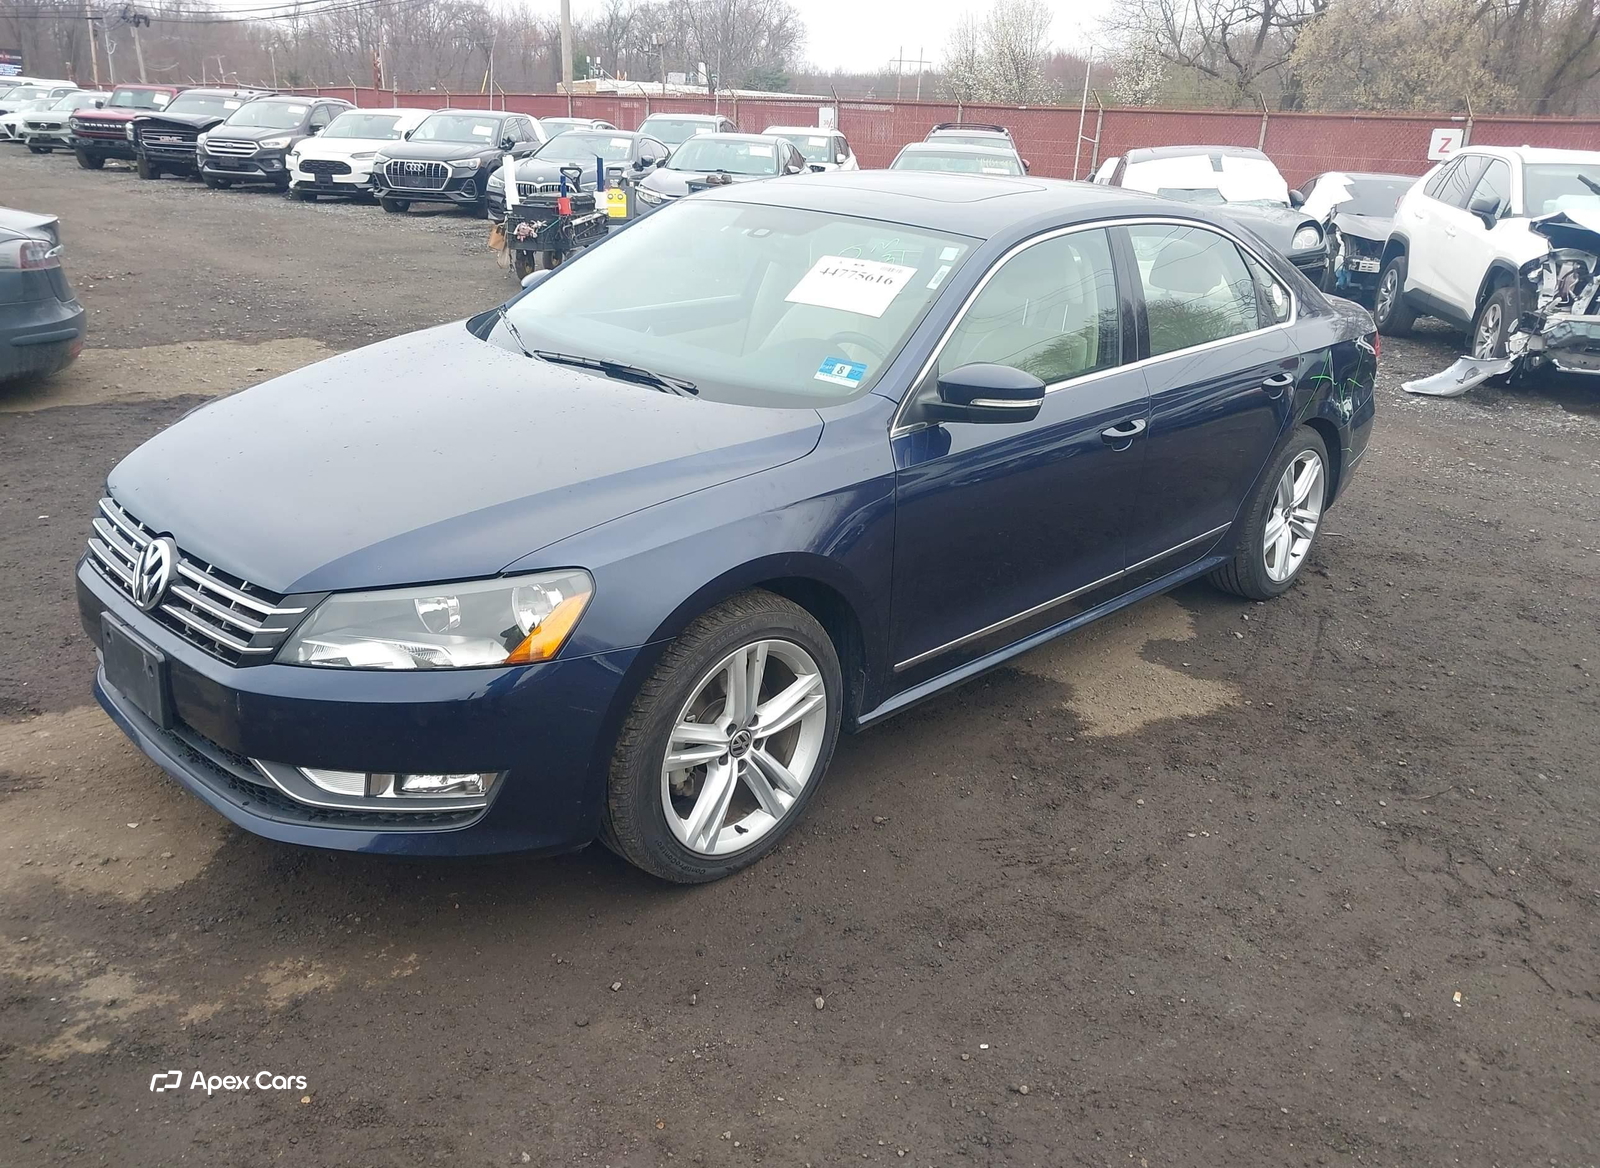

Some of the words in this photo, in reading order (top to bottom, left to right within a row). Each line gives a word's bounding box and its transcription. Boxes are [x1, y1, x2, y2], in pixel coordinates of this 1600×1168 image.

[160, 135, 183, 143] GMC
[1438, 137, 1452, 153] Z
[836, 365, 846, 375] 8
